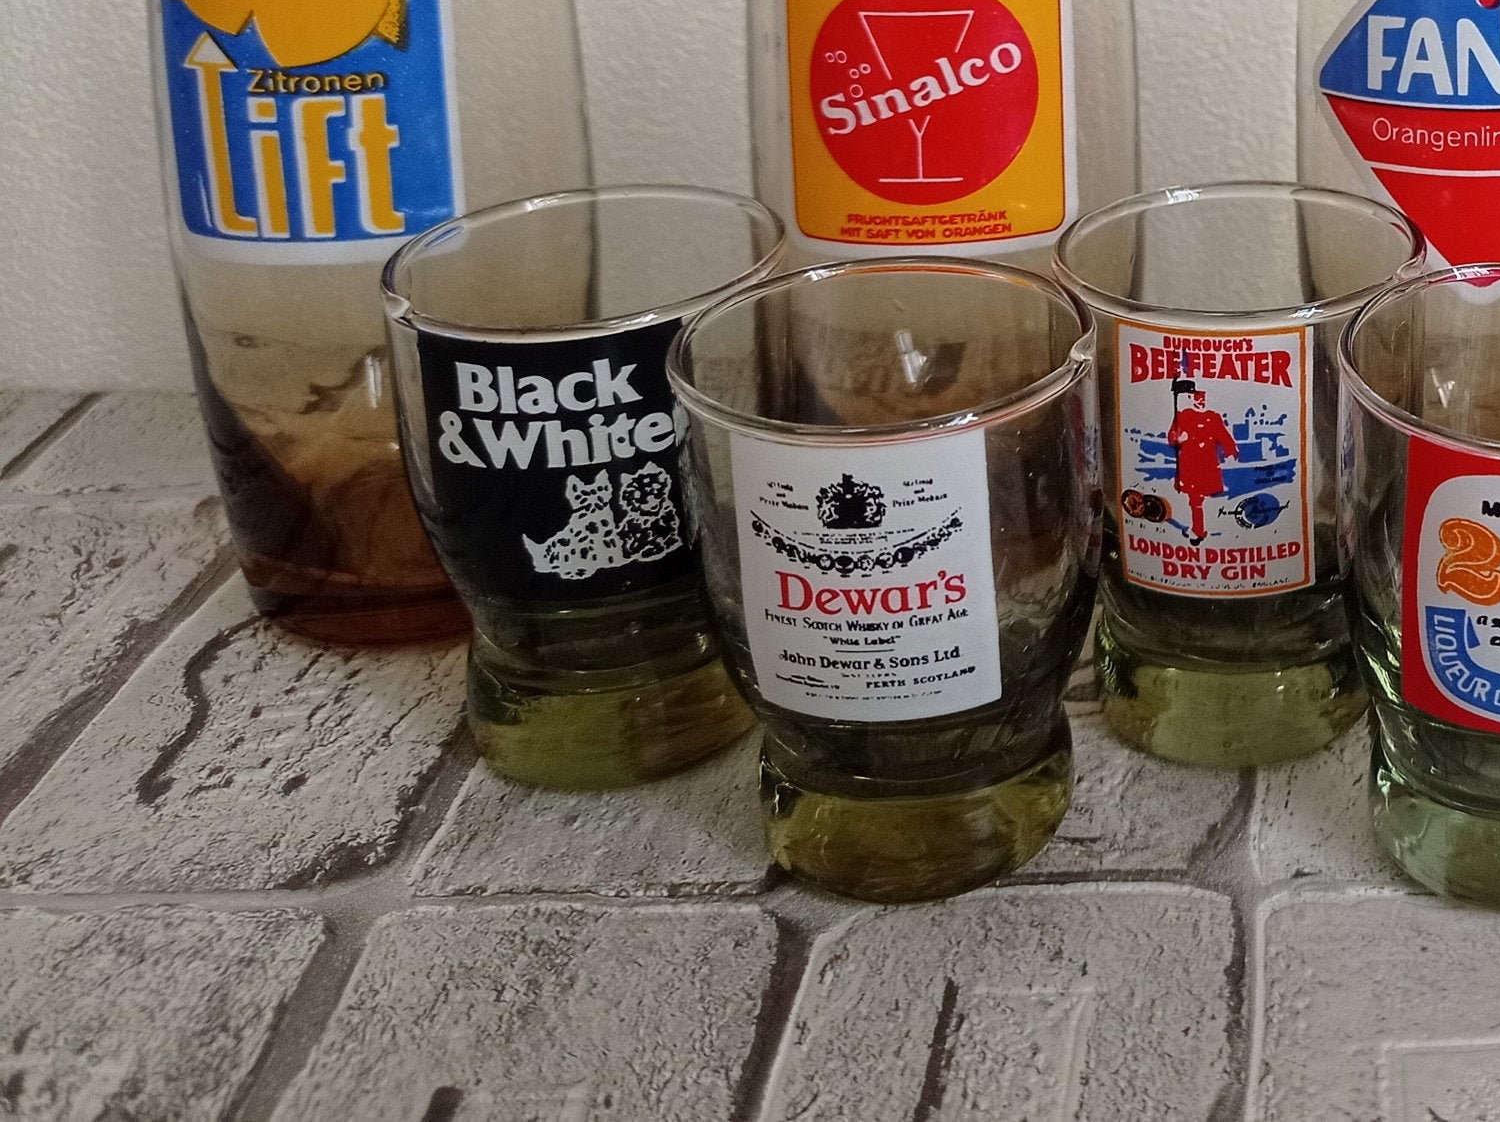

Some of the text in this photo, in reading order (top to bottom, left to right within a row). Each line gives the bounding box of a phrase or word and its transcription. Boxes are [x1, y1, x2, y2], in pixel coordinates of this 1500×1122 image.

[247, 68, 388, 93] Zitronen
[820, 42, 1022, 135] Sinalco
[184, 31, 406, 238] Lift
[840, 223, 1012, 240] MIT SAFT VON ORANGEN
[1163, 335, 1254, 353] BURROUGH'S
[1129, 343, 1293, 388] BEEFEATER
[455, 358, 644, 415] Black
[1128, 533, 1301, 564] LONDON DISTILLED
[1162, 560, 1212, 580] DRY
[1220, 563, 1267, 581] GIN
[774, 569, 967, 616] Dewar's
[1476, 615, 1489, 626] a
[778, 649, 817, 667] John
[819, 656, 871, 670] Dewar
[873, 657, 886, 669] &
[889, 654, 930, 669] Sons
[1433, 614, 1492, 702] LIQUEUR
[865, 665, 977, 689] PERTH SCOTLAND
